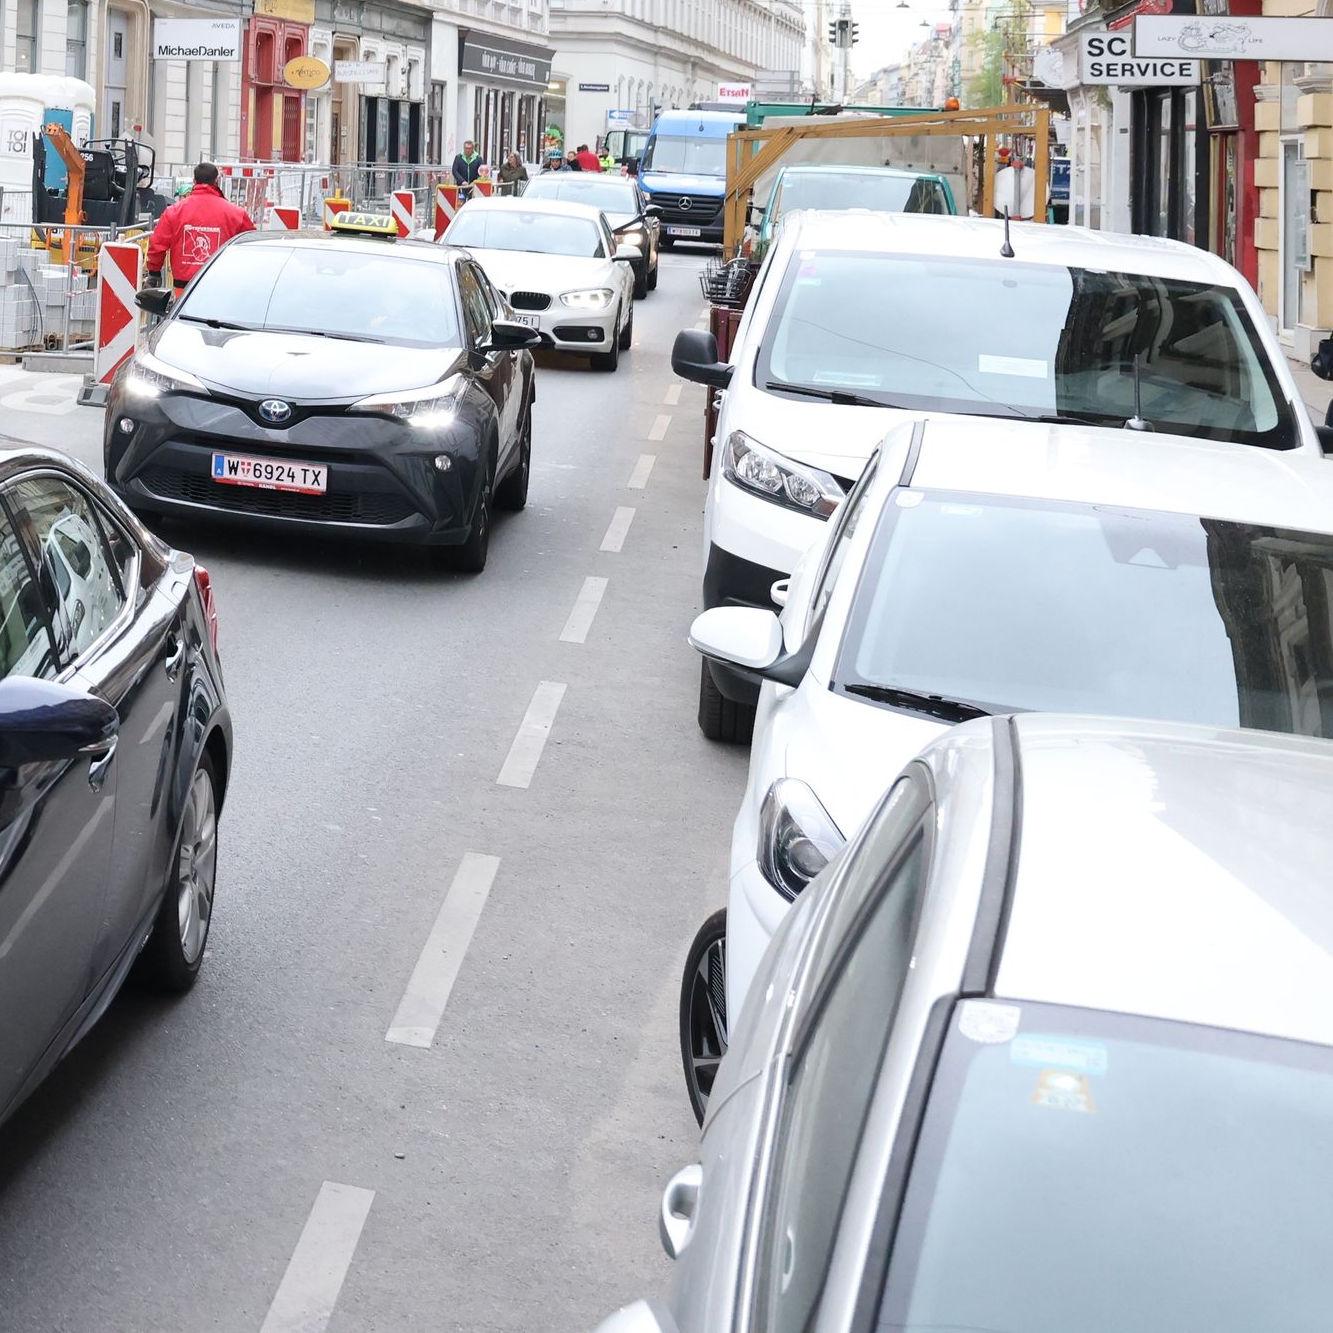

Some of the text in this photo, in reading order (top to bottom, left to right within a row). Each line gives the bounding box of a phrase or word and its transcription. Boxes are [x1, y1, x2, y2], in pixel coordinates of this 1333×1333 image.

[1087, 37, 1132, 57] SC
[1090, 62, 1193, 78] SERVICE
[8, 129, 28, 141] TOI
[7, 142, 26, 153] TOI
[343, 217, 390, 228] TAXI
[253, 462, 296, 483] 6924
[301, 467, 321, 487] TX
